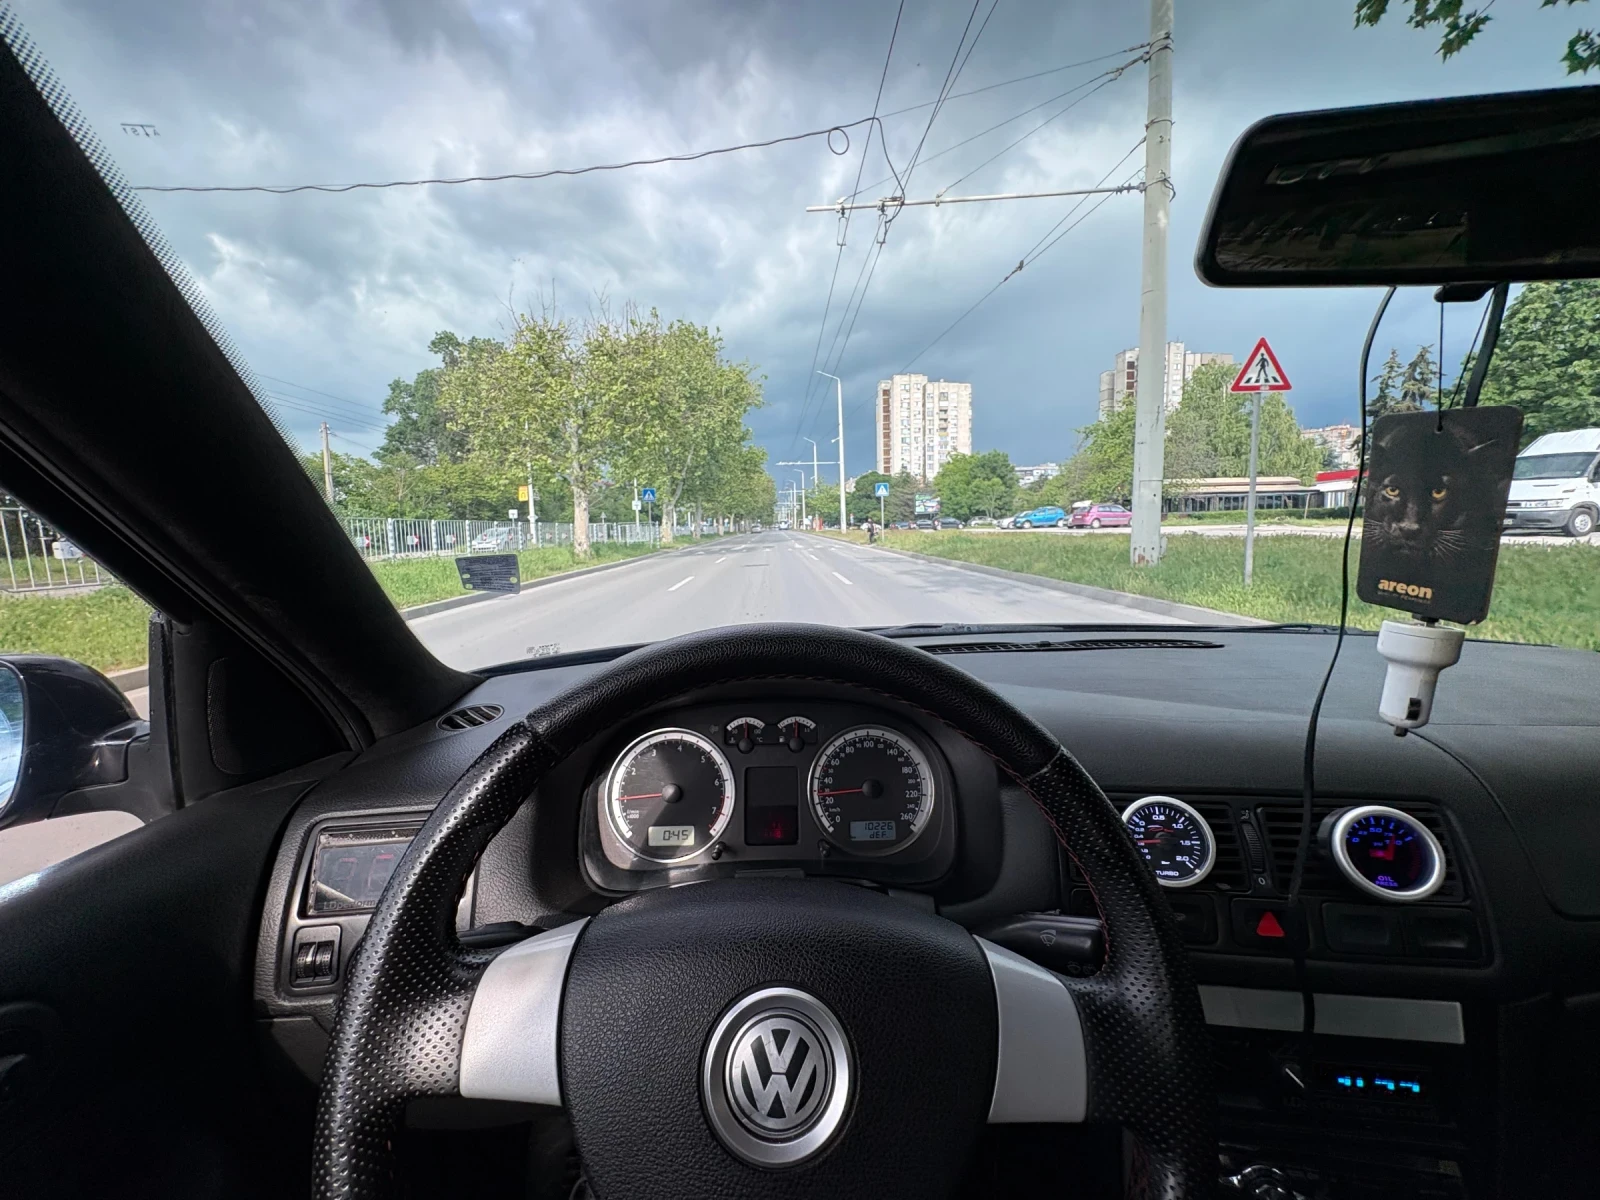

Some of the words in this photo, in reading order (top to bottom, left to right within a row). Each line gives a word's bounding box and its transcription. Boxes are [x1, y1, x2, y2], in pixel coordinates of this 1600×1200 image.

[1377, 579, 1433, 599] areon
[863, 740, 874, 748] 100
[651, 749, 657, 757] 3
[830, 758, 840, 766] 60
[901, 766, 913, 774] 180
[714, 778, 720, 786] 6
[905, 790, 918, 798] 220
[825, 796, 834, 804] 20
[835, 815, 841, 823] 0
[900, 812, 913, 821] 260
[864, 821, 894, 831] 10226
[662, 829, 689, 840] 0:45
